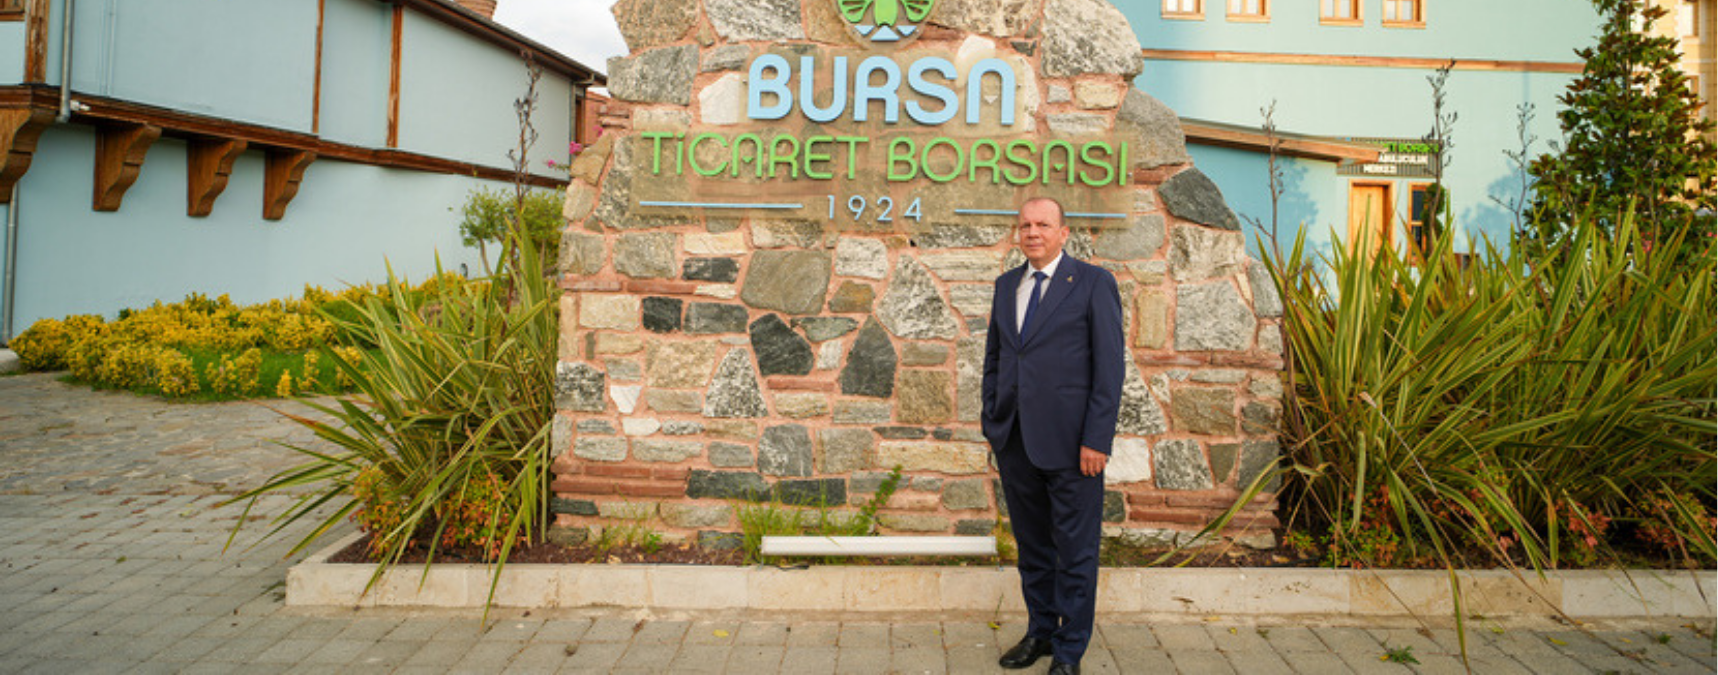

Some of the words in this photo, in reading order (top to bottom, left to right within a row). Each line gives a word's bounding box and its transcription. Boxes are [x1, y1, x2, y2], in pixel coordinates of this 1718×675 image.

[748, 54, 1015, 125] BURSA
[887, 136, 1128, 187] BORSASI
[827, 195, 923, 222] 1924
